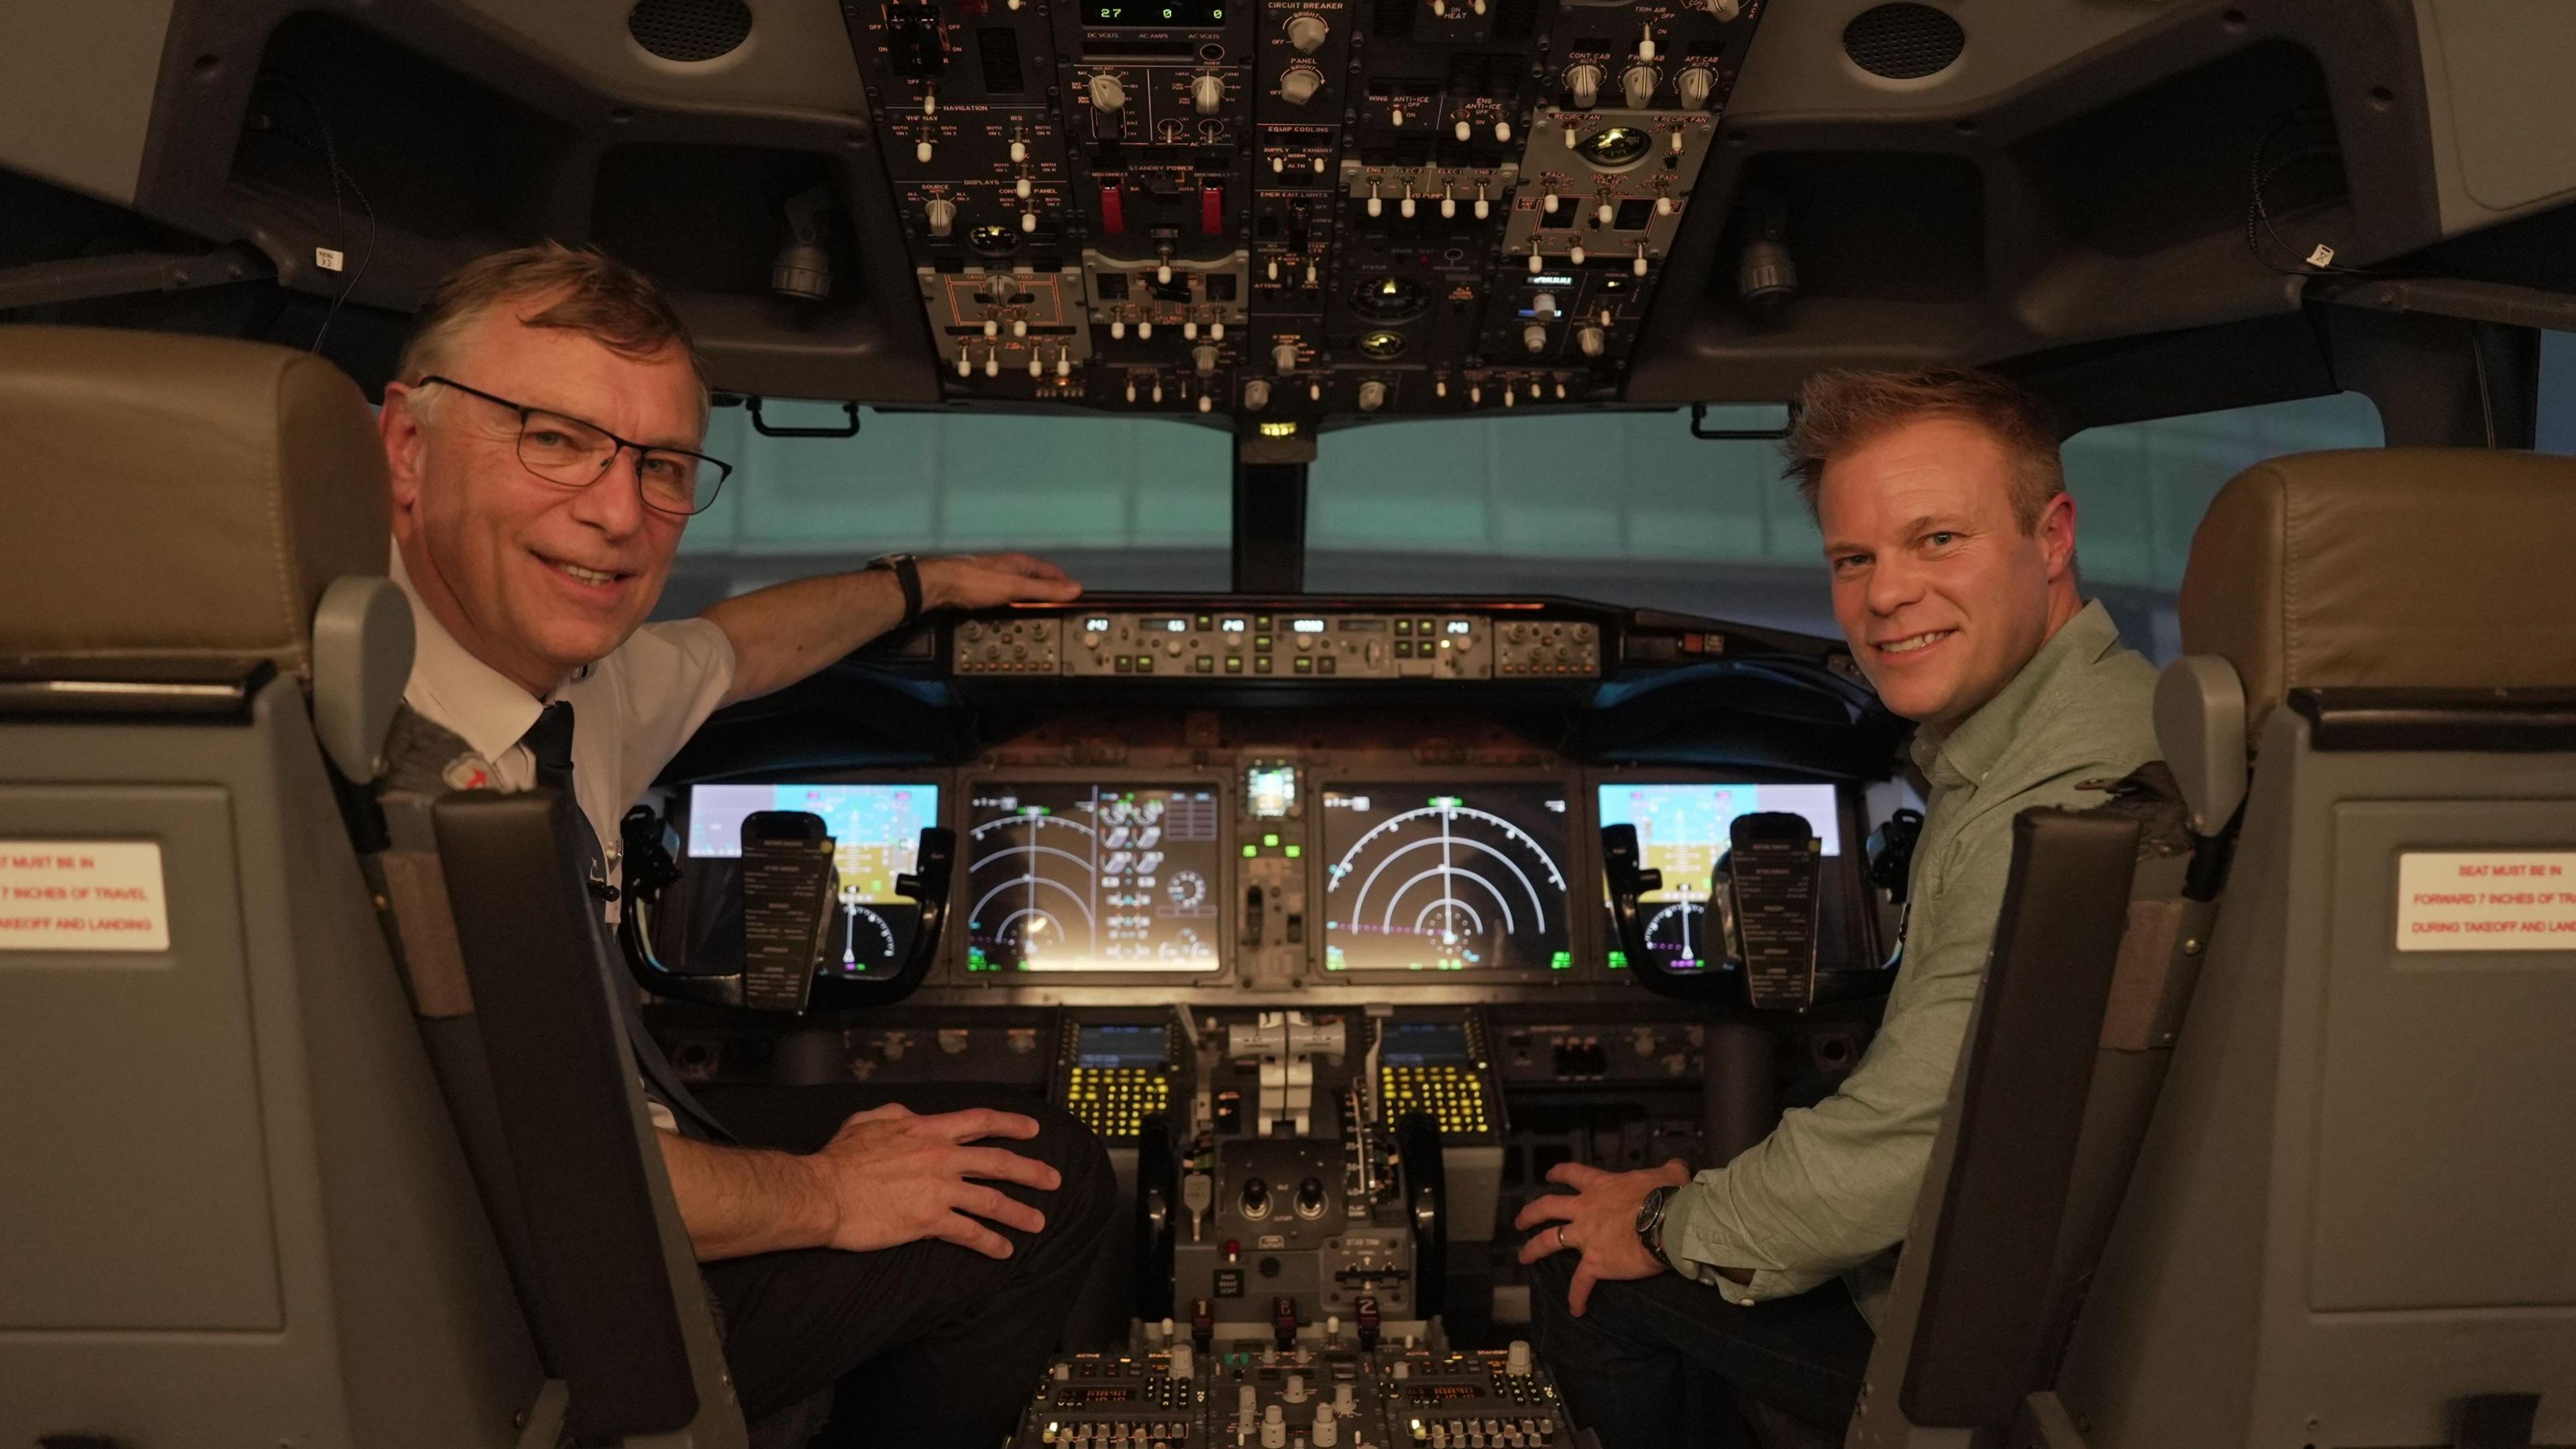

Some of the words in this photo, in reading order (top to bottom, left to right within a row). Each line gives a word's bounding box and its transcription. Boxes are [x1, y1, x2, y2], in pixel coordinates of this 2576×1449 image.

[1101, 8, 1121, 18] 27
[13, 857, 52, 868] MUST
[56, 857, 75, 867] BE
[2459, 865, 2489, 876] SEAT
[2492, 865, 2527, 876] MUST
[2530, 865, 2545, 875] BE
[2549, 865, 2563, 875] IN
[13, 888, 66, 899] INCHES
[71, 888, 90, 899] OF
[95, 888, 148, 900] TRAVEL
[2414, 894, 2475, 904] FORWARD
[2489, 894, 2534, 904] INCHES
[2538, 894, 2555, 904] OF
[56, 918, 85, 930] AND
[89, 918, 152, 930] LANDING
[2412, 922, 2460, 933] DURING
[2464, 922, 2518, 932] TAKEOFF
[2521, 922, 2545, 932] AND
[1197, 1300, 1205, 1316] 1
[1359, 1299, 1377, 1314] 2
